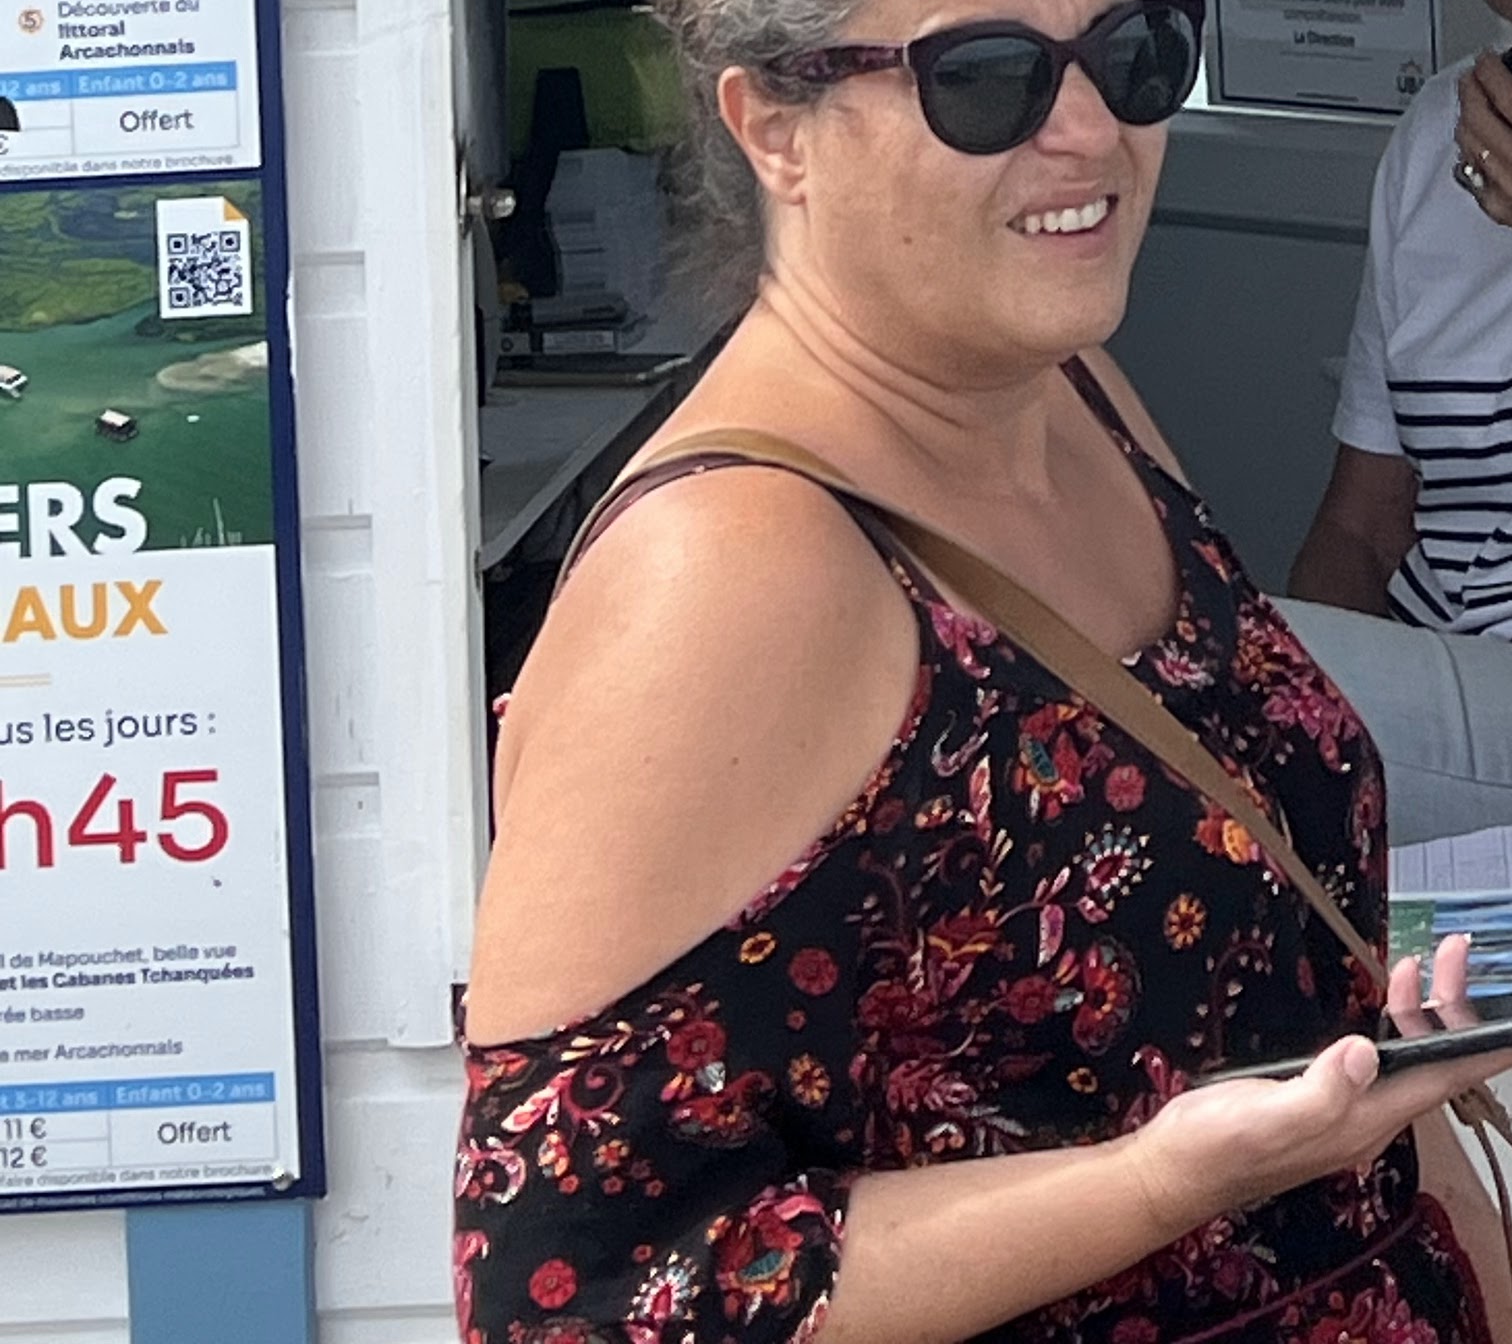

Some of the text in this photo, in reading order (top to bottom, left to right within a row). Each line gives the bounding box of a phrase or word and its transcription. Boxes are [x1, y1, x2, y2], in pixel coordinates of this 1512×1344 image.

[58, 0, 170, 18] Découverte
[58, 21, 125, 39] littoral
[59, 39, 195, 60] Arcachonnais
[78, 74, 144, 93] Enfant
[119, 110, 195, 133] Offert
[3, 579, 168, 643] AUX
[43, 713, 95, 742] les
[103, 709, 198, 748] jours
[21, 974, 48, 989] les
[52, 971, 135, 988] Cabanes
[140, 963, 254, 985] Tchanquées
[0, 1005, 84, 1024] ée basse
[54, 1039, 183, 1060] Arcachonnais
[115, 1086, 182, 1105] Enfant
[157, 1121, 232, 1145] Offert
